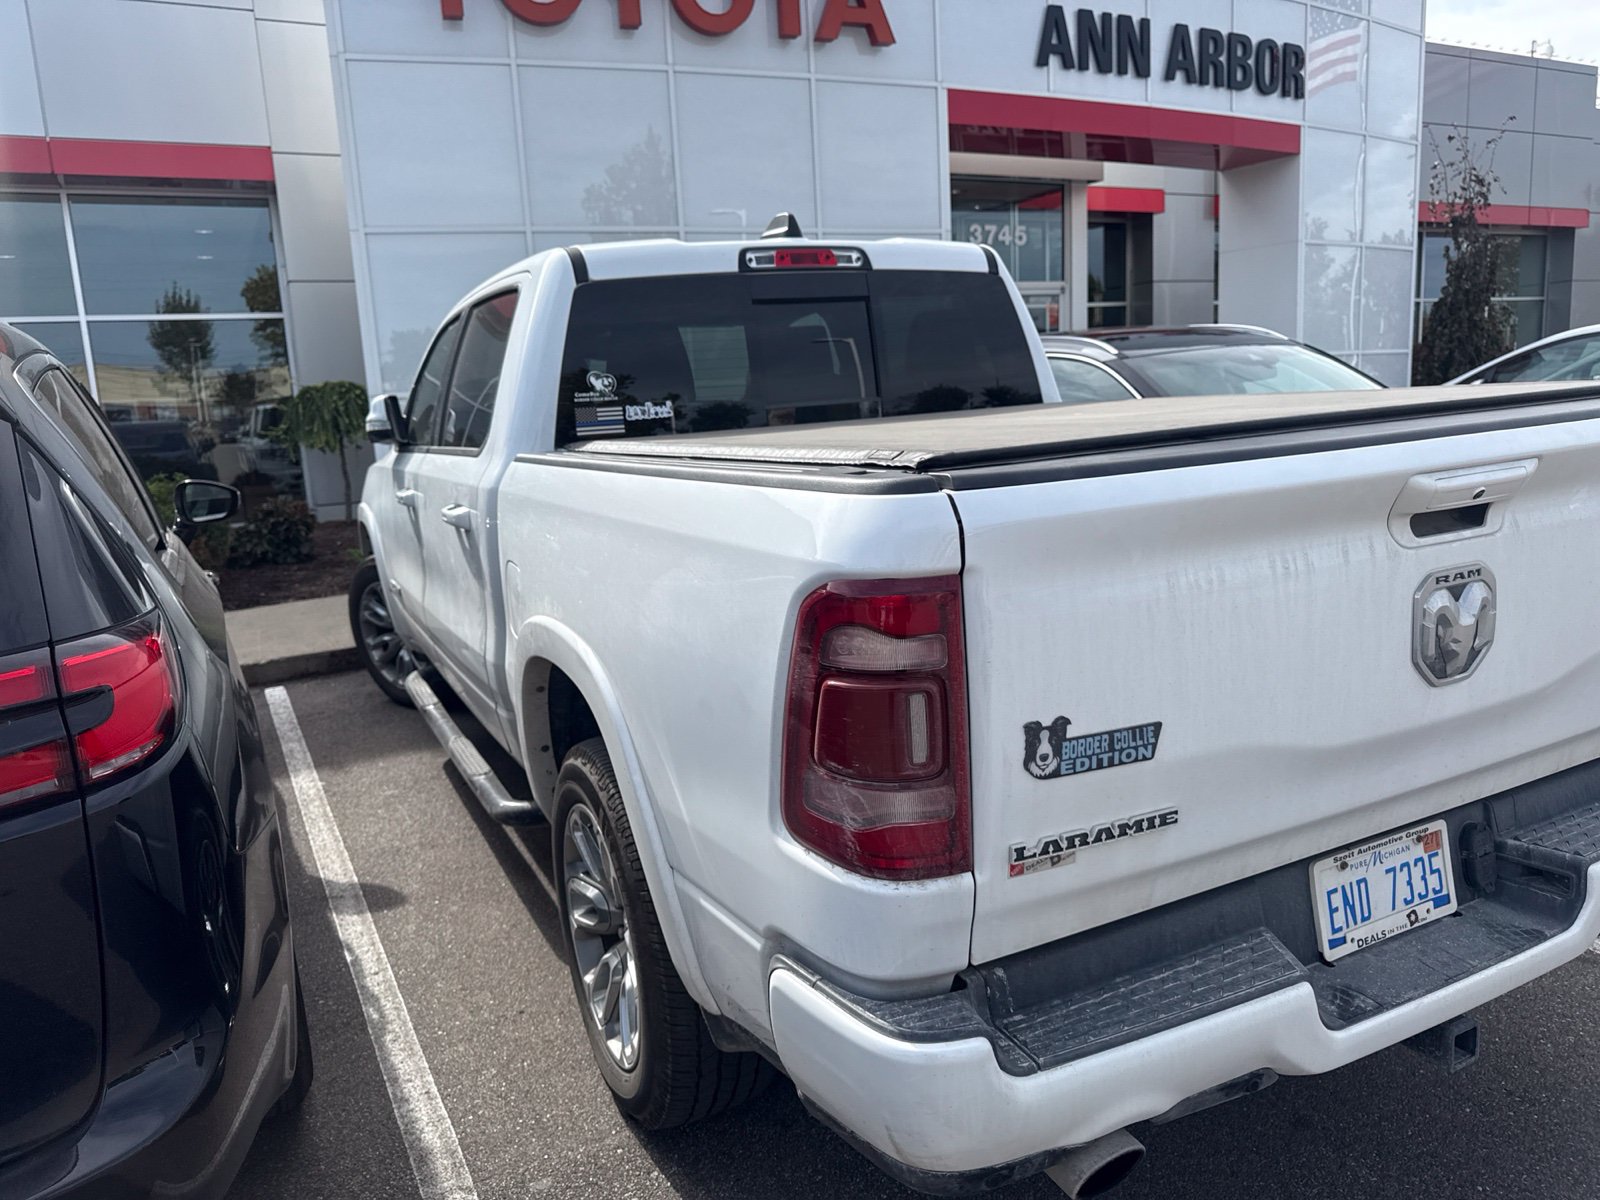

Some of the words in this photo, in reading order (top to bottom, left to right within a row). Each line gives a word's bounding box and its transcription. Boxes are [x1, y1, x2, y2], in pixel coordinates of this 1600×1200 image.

[1036, 4, 1150, 78] ANN
[1164, 23, 1305, 100] ARBOR
[969, 223, 1028, 246] 3745
[1435, 567, 1482, 585] RAM
[1062, 736, 1109, 760] BORDER
[1113, 726, 1156, 750] COLLIE
[1060, 745, 1153, 775] EDITION
[1012, 809, 1179, 863] LARAMIE
[1333, 851, 1355, 864] Szott
[1357, 835, 1403, 855] Automotive
[1405, 826, 1430, 839] Group
[1350, 860, 1368, 871] PURE
[1366, 844, 1411, 873] MICHIGAN
[1326, 876, 1372, 936] END
[1384, 851, 1444, 911] 7335
[1356, 929, 1387, 948] DEALS
[1387, 928, 1395, 936] IN
[1396, 923, 1408, 932] THE
